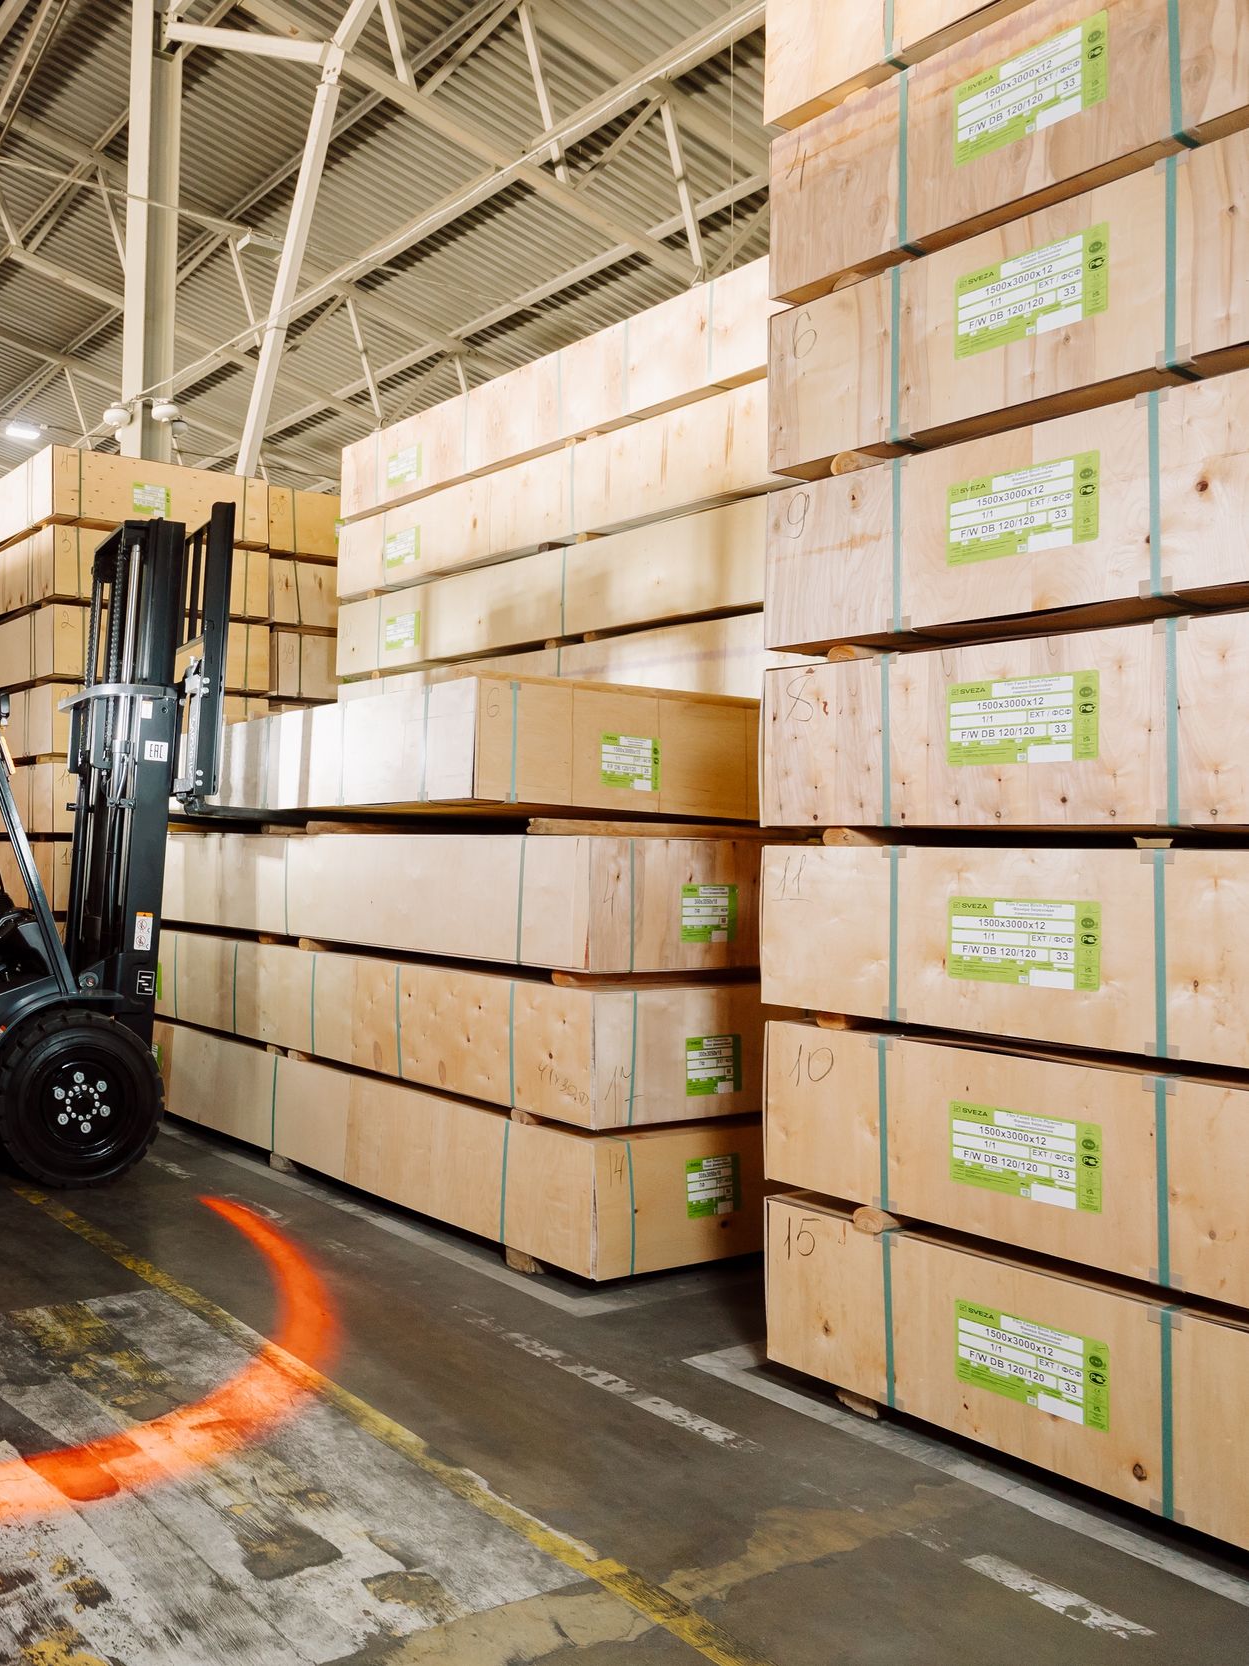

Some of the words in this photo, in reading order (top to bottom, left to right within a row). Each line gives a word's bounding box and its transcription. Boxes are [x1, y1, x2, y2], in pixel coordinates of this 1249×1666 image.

[985, 60, 1052, 99] 1500x3000x12
[1038, 75, 1053, 86] EXT
[1063, 78, 1075, 90] 33
[990, 99, 1001, 110] 1/1
[969, 120, 986, 135] F/W
[990, 113, 1002, 126] DB
[1008, 94, 1043, 115] 120/120
[968, 271, 994, 285] SVEZA
[986, 265, 1053, 295] 1500x3000x12
[1039, 278, 1053, 289] EXT
[1064, 286, 1075, 296] 33
[990, 297, 1002, 307] 1/1
[969, 315, 986, 329] F/W
[990, 311, 1003, 322] DB
[1008, 297, 1044, 316] 120/120
[793, 311, 817, 359] 6
[960, 483, 986, 493] SVEZA
[977, 485, 1044, 507] 1500x3000x12
[1030, 498, 1045, 507] EXT
[787, 492, 810, 539] 9
[982, 510, 993, 519] 1/1
[1055, 510, 1067, 519] 33
[961, 526, 978, 538] F/W
[982, 523, 995, 534] DB
[1000, 516, 1034, 530] 120/120
[61, 529, 71, 553] 3
[786, 675, 813, 721] 8
[977, 697, 1043, 710] 1500x3000x12
[961, 730, 979, 739] F/W
[982, 729, 994, 738] DB
[999, 727, 1034, 736] 120/120
[1055, 725, 1067, 733] 33
[979, 919, 1045, 929] 1500x3000x12
[963, 945, 980, 953] F/W
[983, 947, 996, 955] DB
[1001, 948, 1036, 958] 120/120
[1057, 952, 1069, 960] 33
[789, 1044, 834, 1087] 10
[962, 1108, 988, 1117] SVEZA
[980, 1126, 1046, 1145] 1500x3000x12
[985, 1141, 996, 1149] 1/1
[1033, 1150, 1047, 1158] EXT
[964, 1150, 981, 1160] F/W
[984, 1154, 998, 1164] DB
[1002, 1158, 1037, 1172] 120/120
[609, 1149, 625, 1188] 14
[1058, 1170, 1070, 1179] 33
[784, 1217, 822, 1260] 15
[968, 1308, 994, 1320] SVEZA
[986, 1329, 1053, 1356] 1500x3000x12
[991, 1344, 1002, 1353] 1/1
[970, 1351, 987, 1363] F/W
[991, 1357, 1003, 1369] DB
[1008, 1363, 1044, 1382] 120/120
[1039, 1359, 1054, 1369] EXT
[1065, 1382, 1077, 1393] 33
